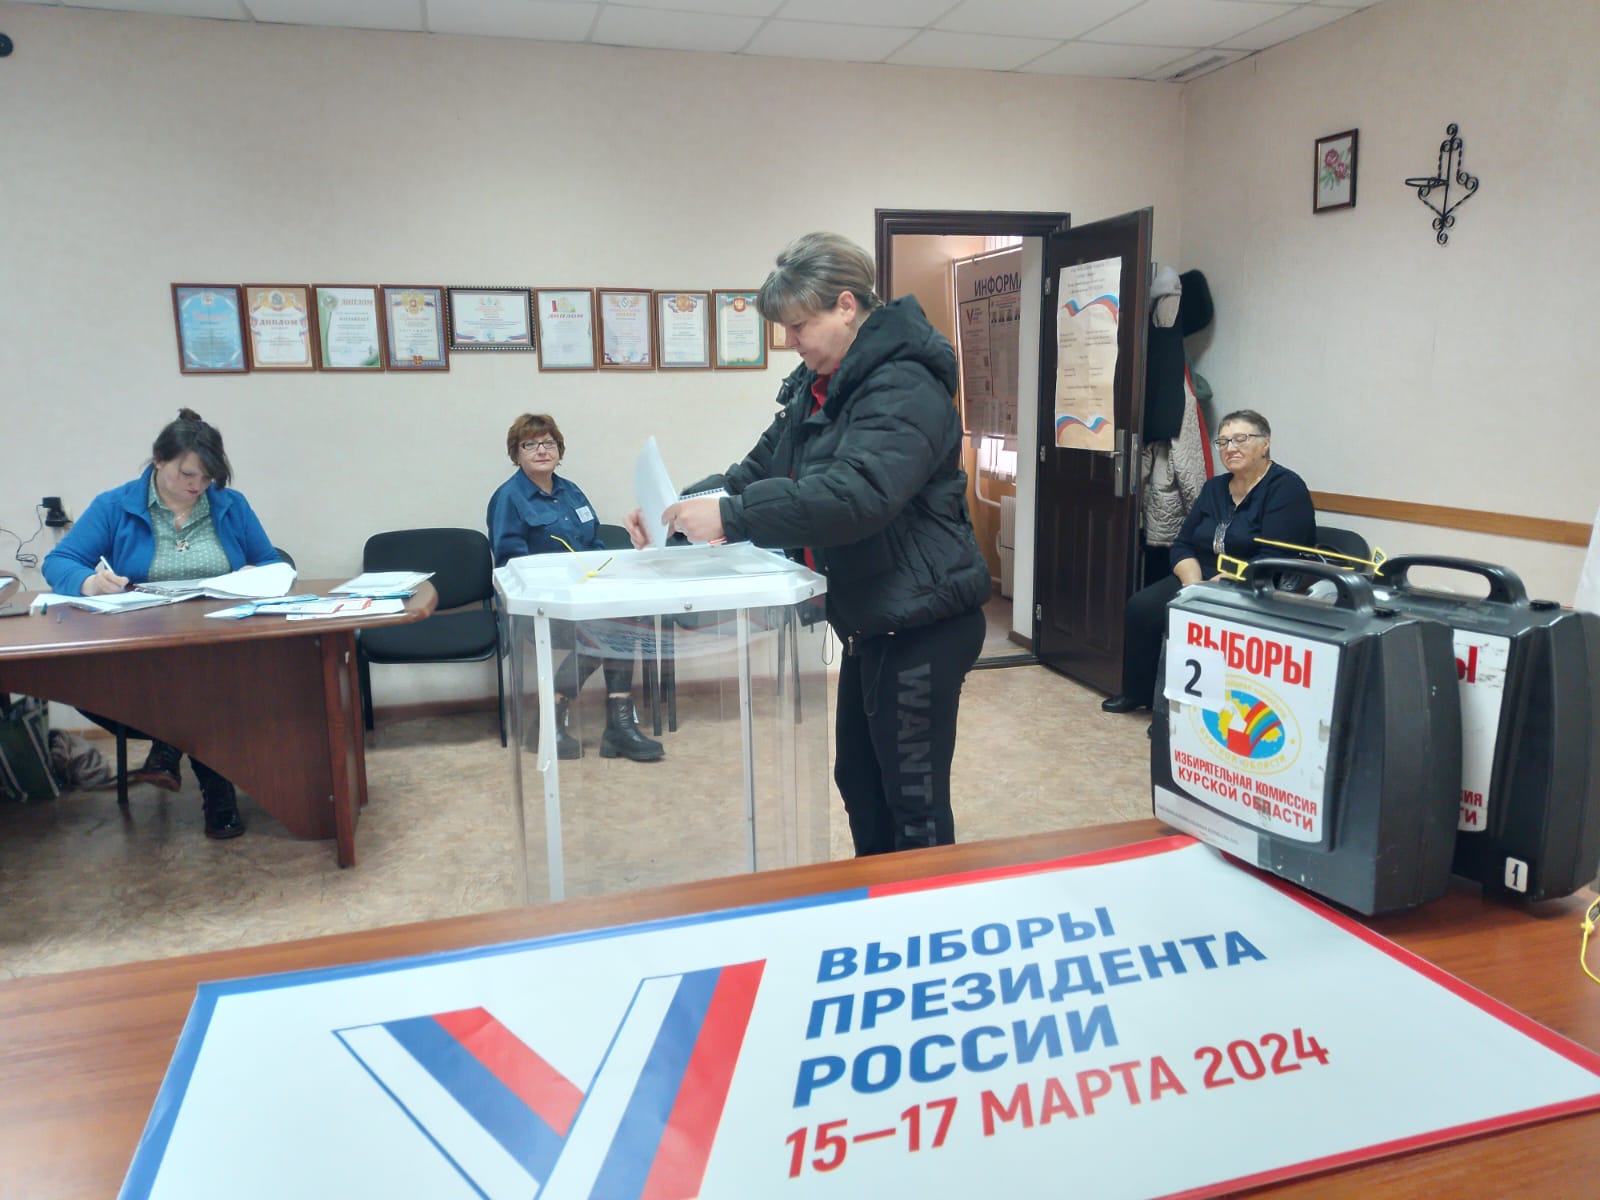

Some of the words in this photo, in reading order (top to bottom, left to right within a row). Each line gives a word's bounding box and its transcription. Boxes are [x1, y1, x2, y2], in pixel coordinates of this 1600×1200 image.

[1184, 658, 1203, 698] 2
[1187, 622, 1313, 688] ВЫБОРЫ
[897, 662, 934, 805] WANT
[1174, 750, 1253, 791] ИЗБИРАТЕЛЬНАЯ
[1255, 780, 1317, 817] КОМИССИЯ
[1178, 767, 1238, 802] КУРСКОЙ
[1241, 792, 1313, 832] ОБЛАСТИ
[816, 907, 1116, 984] ВЫБОРЫ
[805, 930, 1268, 1040] ПРЕЗИДЕНТА
[793, 1004, 1119, 1109] РОССИИ
[980, 1056, 1187, 1137] МАРТА
[1194, 1028, 1330, 1089] 2024
